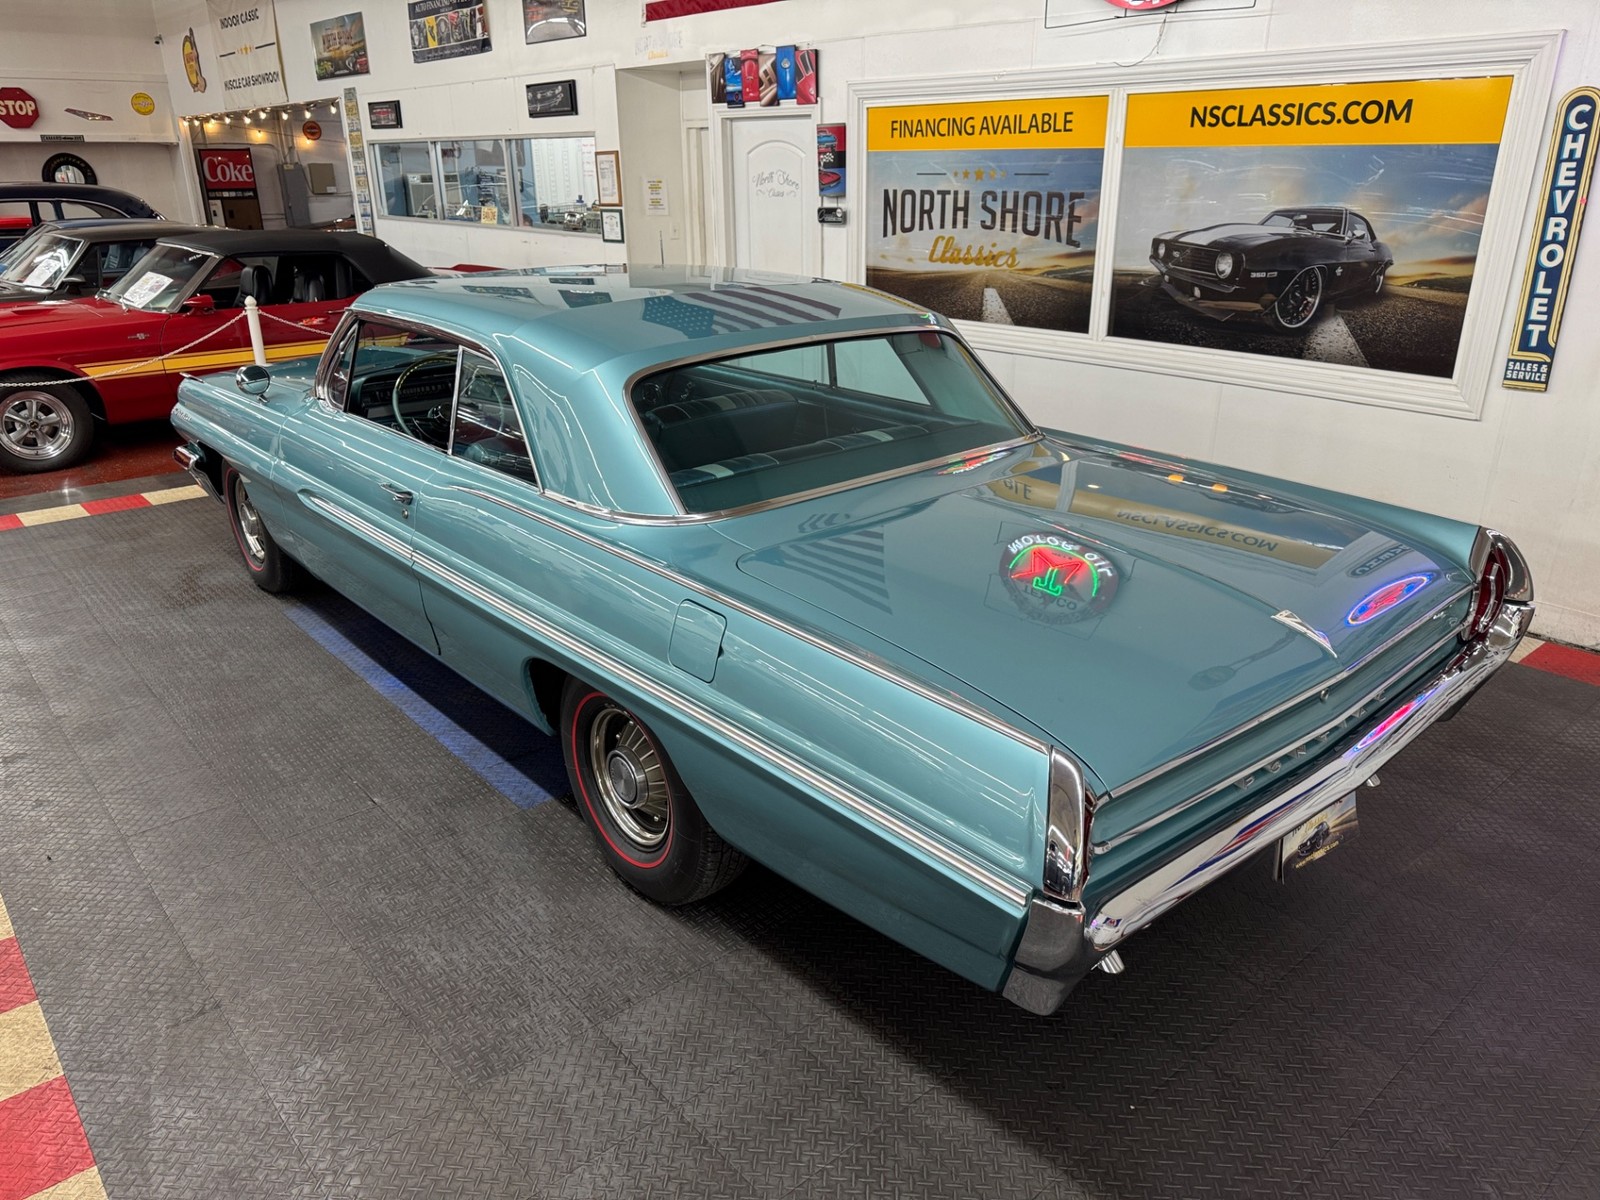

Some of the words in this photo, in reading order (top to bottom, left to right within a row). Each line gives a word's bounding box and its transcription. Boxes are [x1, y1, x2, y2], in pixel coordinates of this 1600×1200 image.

[0, 101, 36, 116] STOP
[1190, 98, 1414, 128] NSCLASSICS.COM
[890, 116, 976, 139] FINANCING
[979, 111, 1074, 137] AVAILABLE
[203, 156, 254, 183] Coke
[882, 188, 970, 239] NORTH
[980, 190, 1085, 249] SHORE
[1526, 103, 1592, 348] CHEVROLET
[928, 235, 1021, 269] Classics
[1506, 370, 1547, 382] SERVICE
[1508, 361, 1539, 372] SALES
[1540, 364, 1548, 373] &
